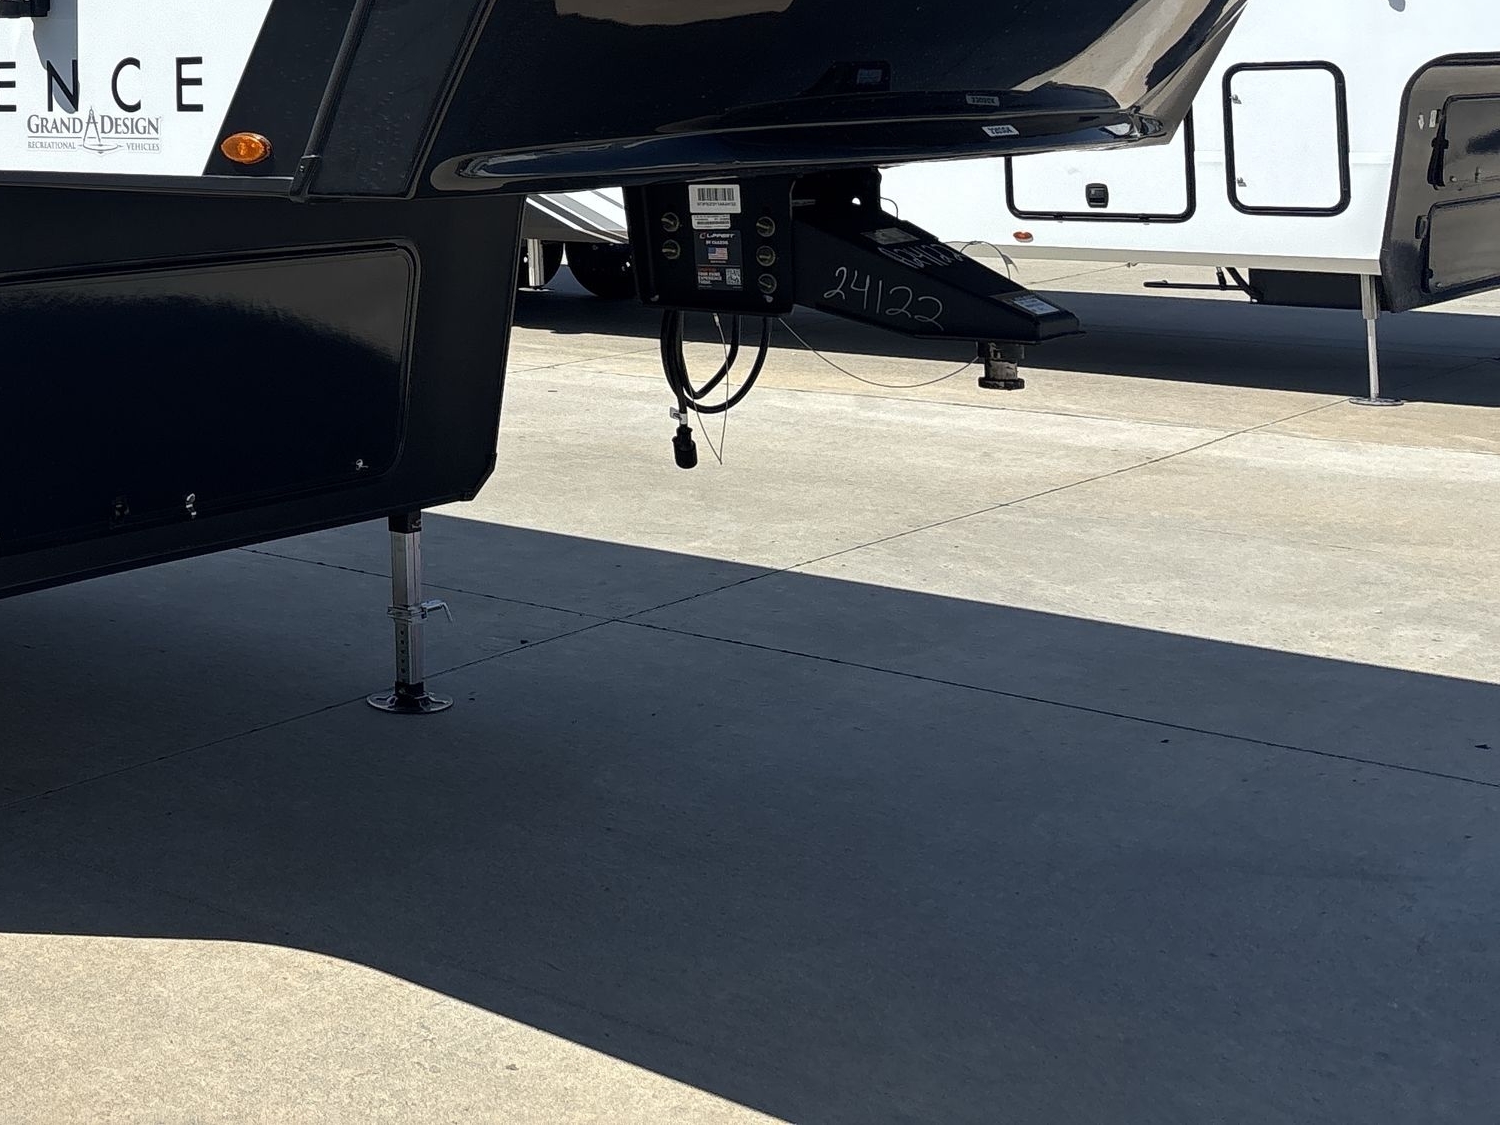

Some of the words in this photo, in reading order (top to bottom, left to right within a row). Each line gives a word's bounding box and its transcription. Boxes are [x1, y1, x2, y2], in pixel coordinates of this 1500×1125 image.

[27, 114, 83, 134] GRAND
[100, 114, 160, 135] DESIGN
[27, 140, 76, 150] RECREATIONAL
[126, 142, 160, 152] VEHICLES
[823, 266, 944, 332] 24122
